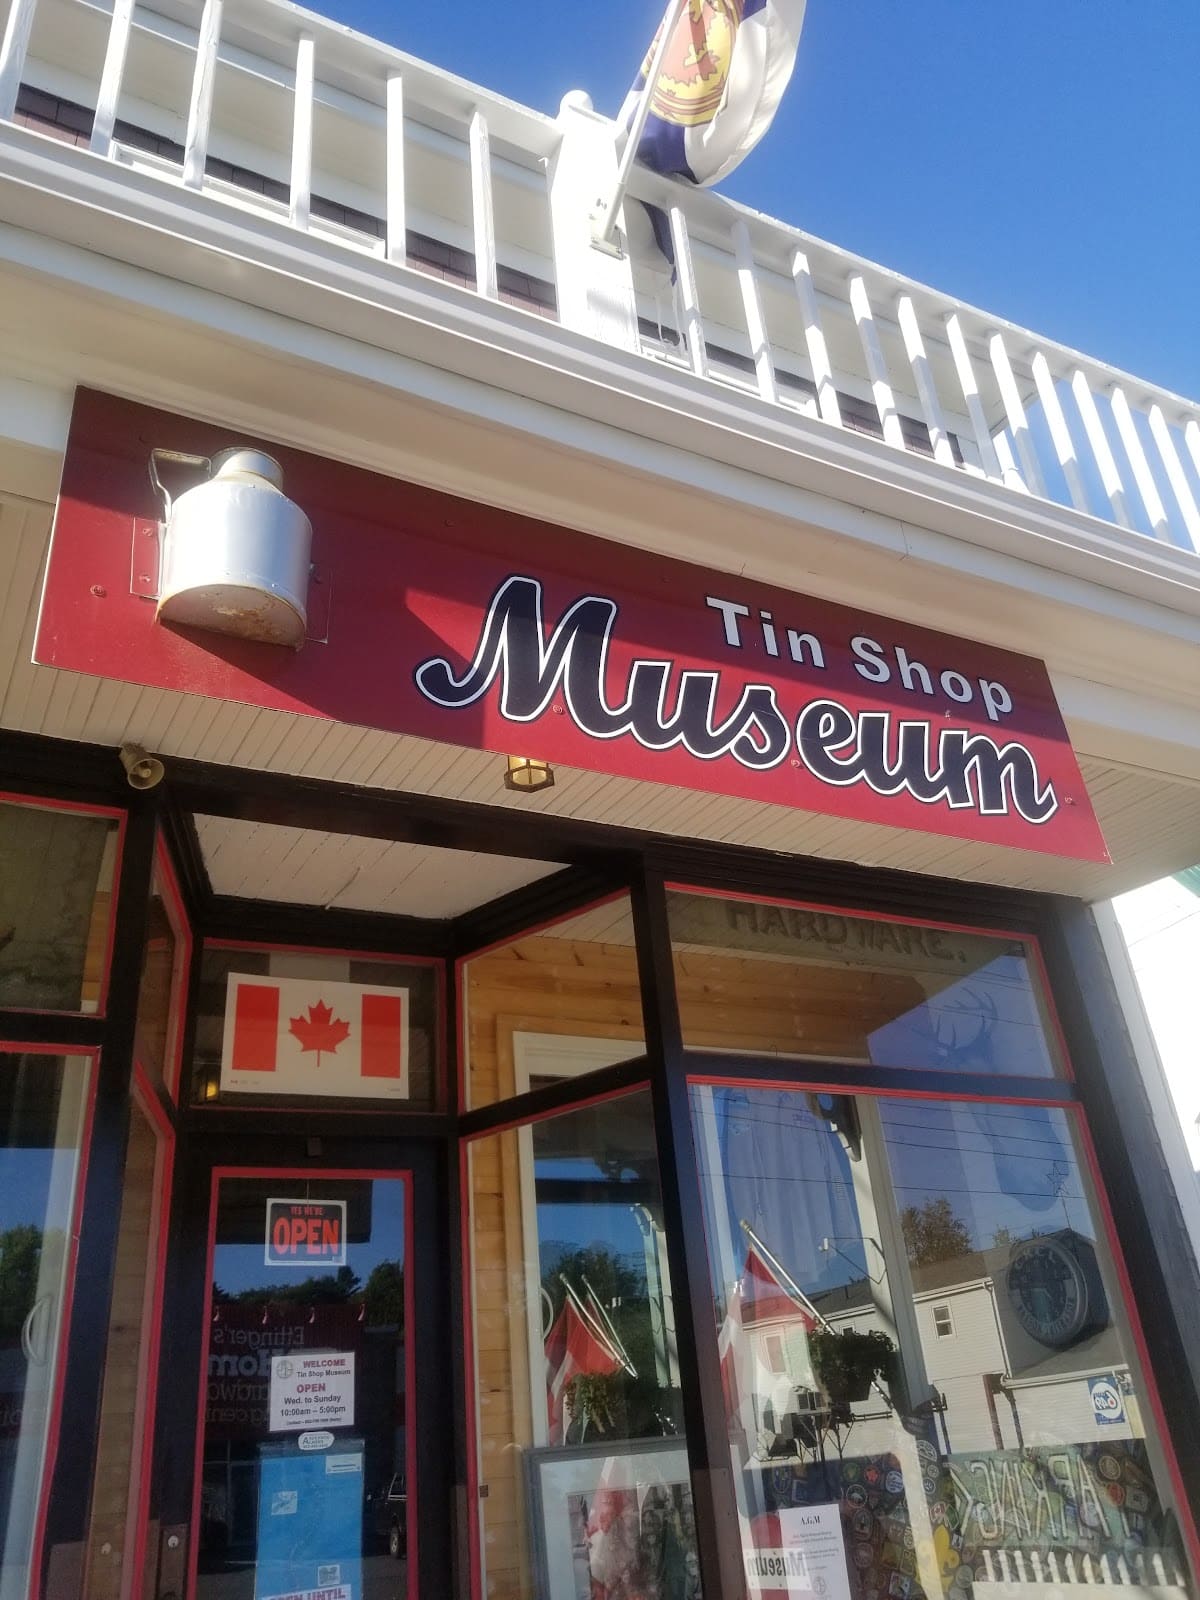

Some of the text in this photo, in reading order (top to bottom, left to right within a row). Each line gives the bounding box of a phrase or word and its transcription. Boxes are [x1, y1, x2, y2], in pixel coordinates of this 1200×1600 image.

[704, 594, 1015, 722] Tin Shop
[413, 574, 1059, 826] Museum
[290, 1206, 302, 1215] YES
[273, 1217, 339, 1256] OPEN
[303, 1358, 346, 1369] WELCOME
[309, 1370, 324, 1378] Shop
[325, 1368, 351, 1376] Museum
[296, 1383, 327, 1394] OPEN
[284, 1396, 304, 1405] Wed.
[313, 1394, 342, 1405] Sunday
[280, 1407, 311, 1417] 10:00am
[319, 1405, 346, 1416] 5:00pm
